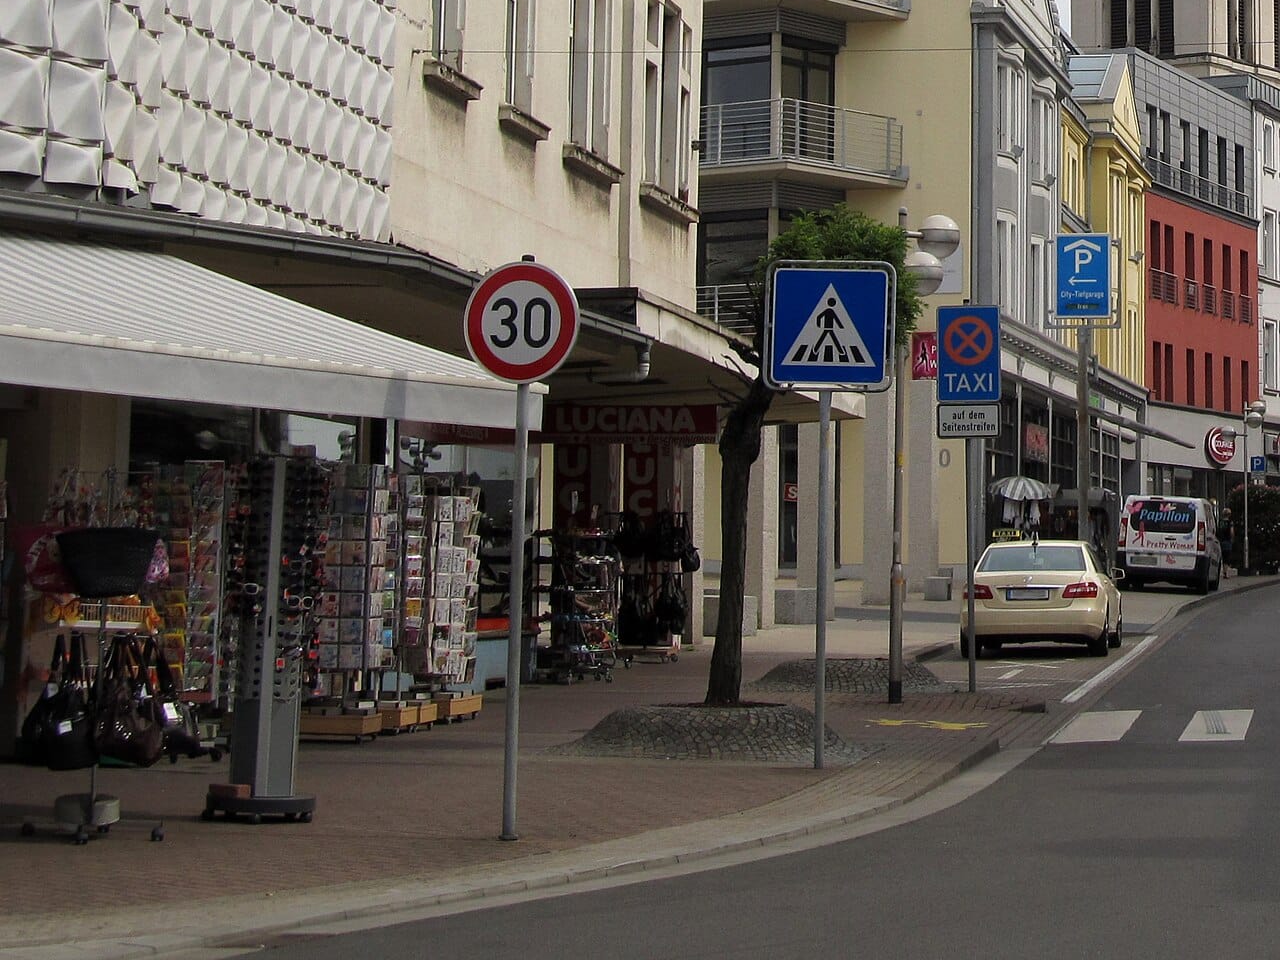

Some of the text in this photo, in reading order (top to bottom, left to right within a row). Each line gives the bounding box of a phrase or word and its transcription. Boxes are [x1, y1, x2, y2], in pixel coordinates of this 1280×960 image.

[1075, 249, 1092, 273] P
[490, 297, 552, 349] 30
[944, 373, 993, 393] TAXI
[556, 407, 696, 433] LUCIANA
[952, 410, 985, 420] auf dem
[942, 422, 996, 432] Seitenstreifen
[1253, 458, 1262, 469] P
[1140, 509, 1190, 522] Papillon
[1146, 541, 1168, 549] Pretty
